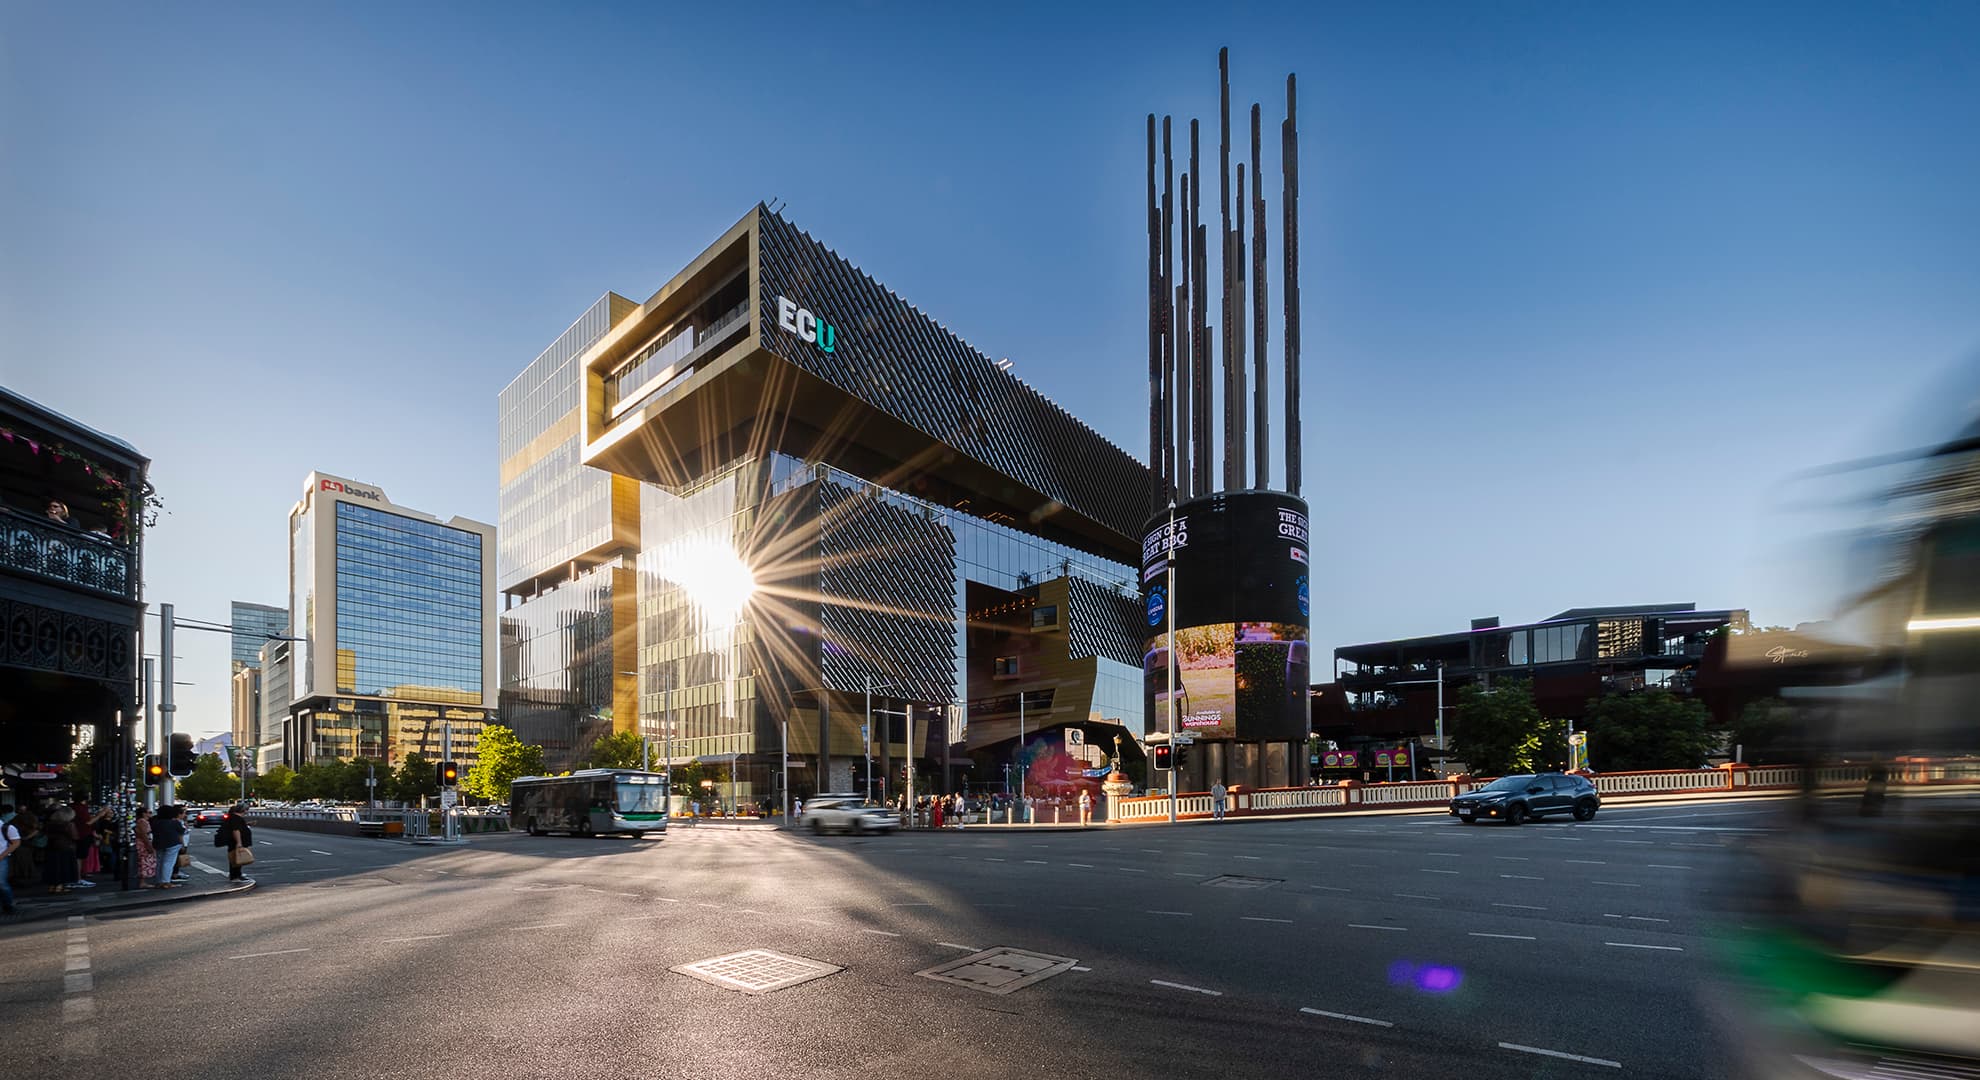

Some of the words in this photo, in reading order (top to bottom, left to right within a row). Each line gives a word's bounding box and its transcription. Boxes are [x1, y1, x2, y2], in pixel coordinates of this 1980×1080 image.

[778, 295, 835, 353] ECU
[344, 484, 381, 502] bank
[1179, 520, 1188, 531] A
[1278, 511, 1297, 524] THE
[1161, 532, 1188, 551] BBQ
